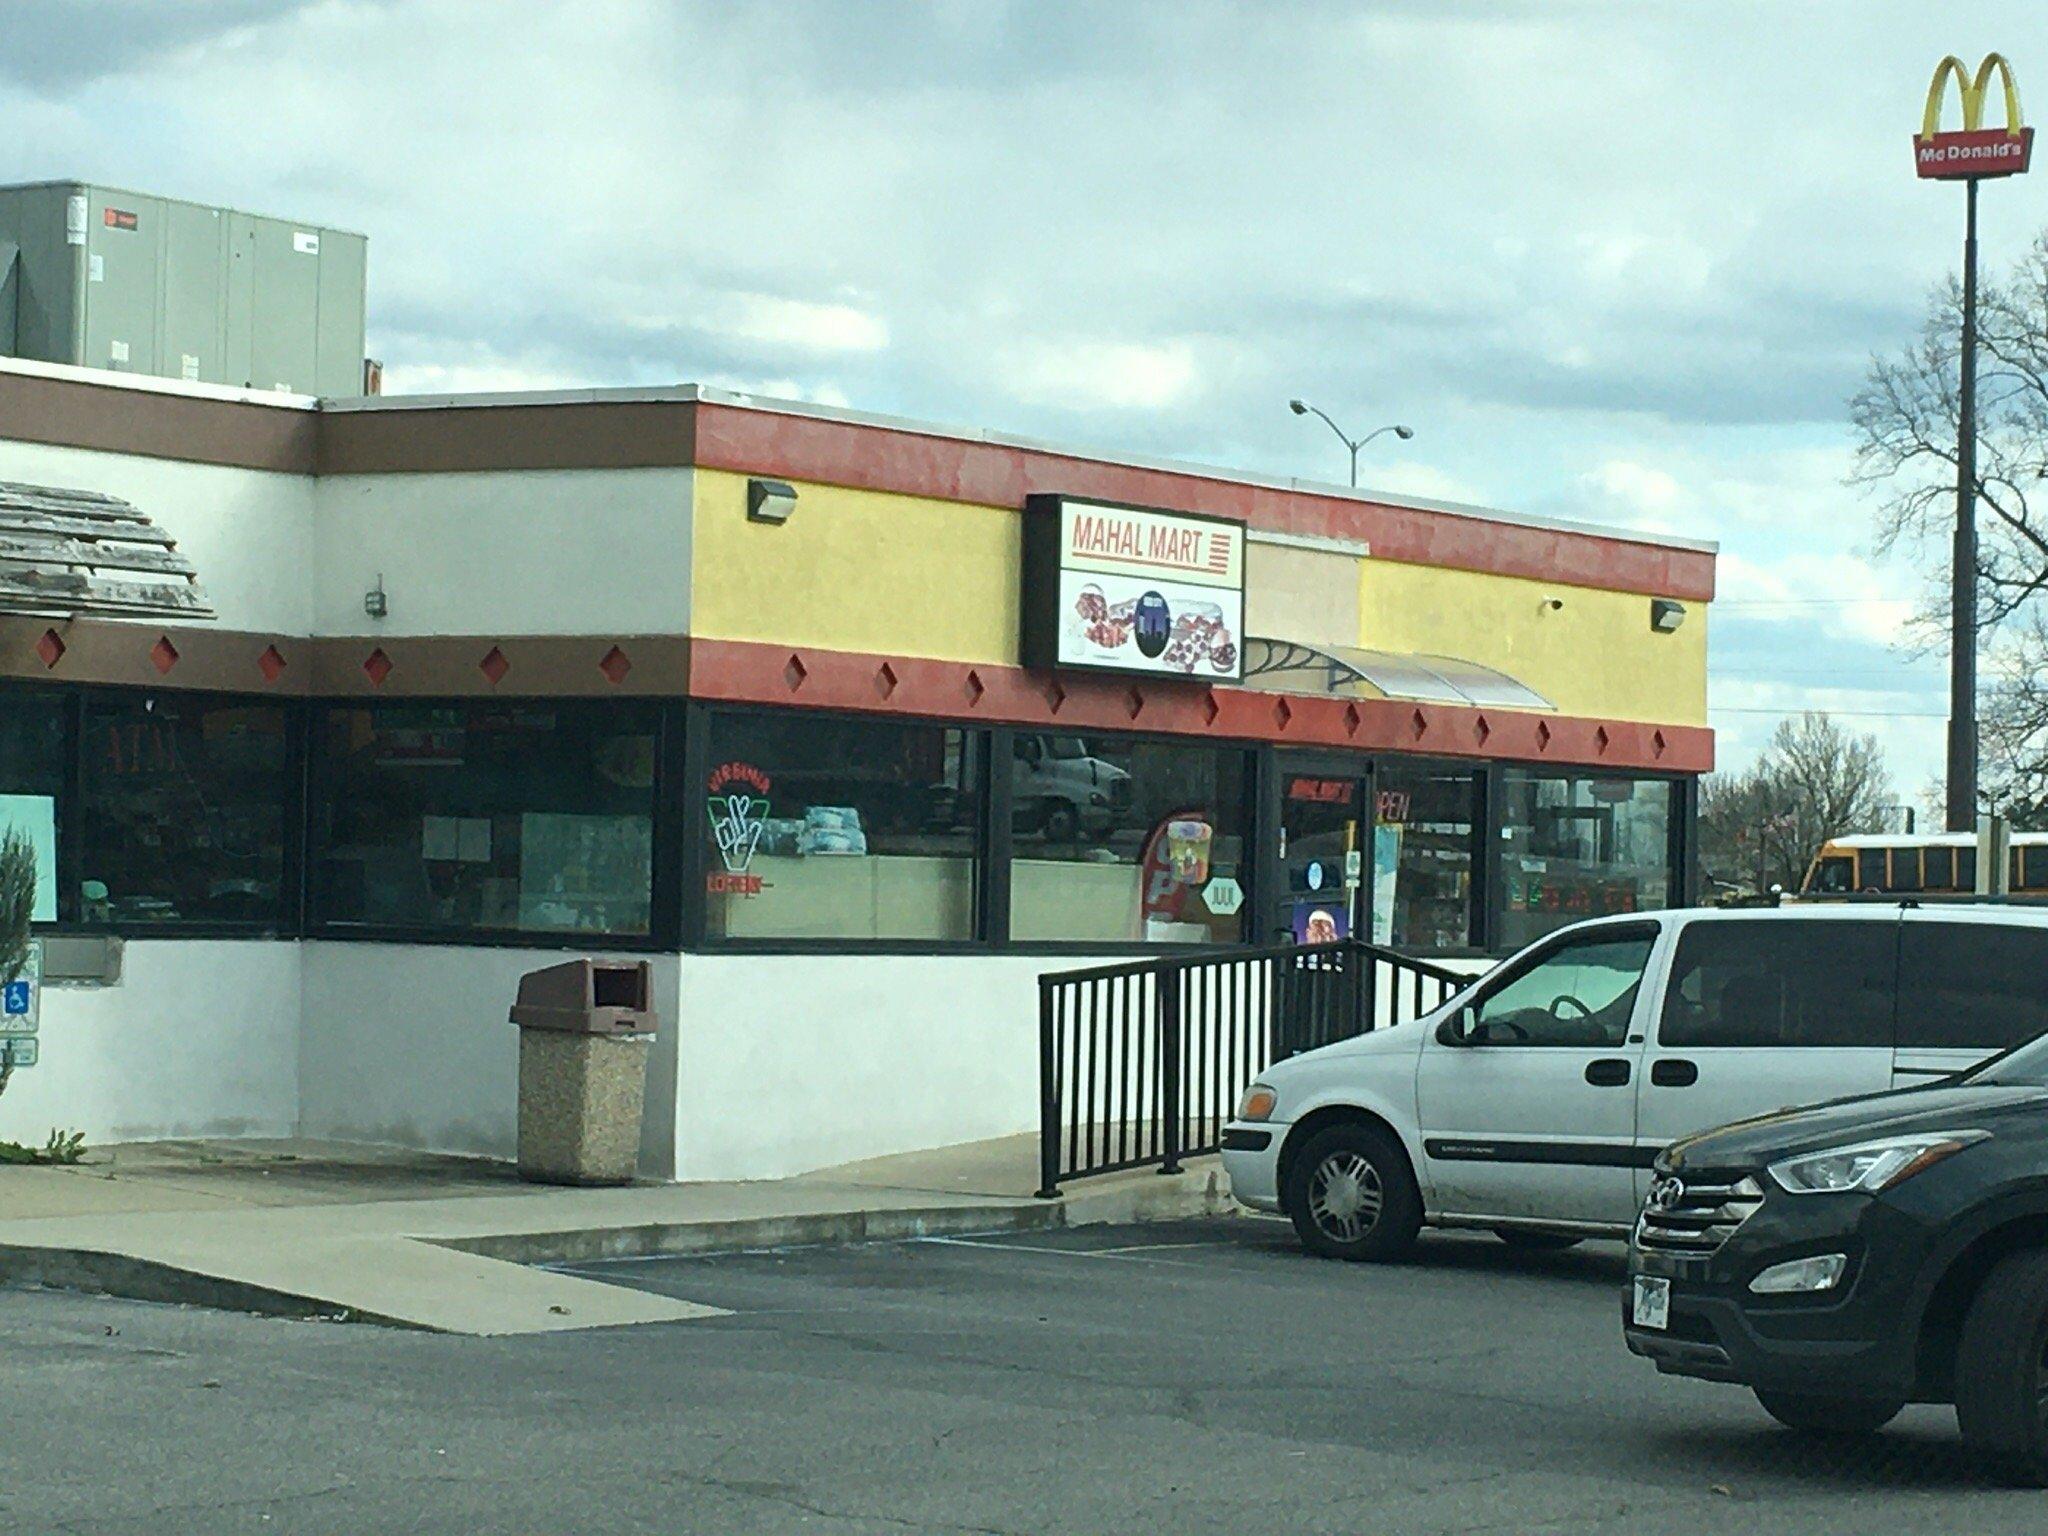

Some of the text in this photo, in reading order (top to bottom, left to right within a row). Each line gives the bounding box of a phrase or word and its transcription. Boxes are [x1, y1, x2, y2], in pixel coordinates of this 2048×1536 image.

[1919, 143, 2021, 163] McDonald's
[1072, 514, 1203, 564] MAHAL MART
